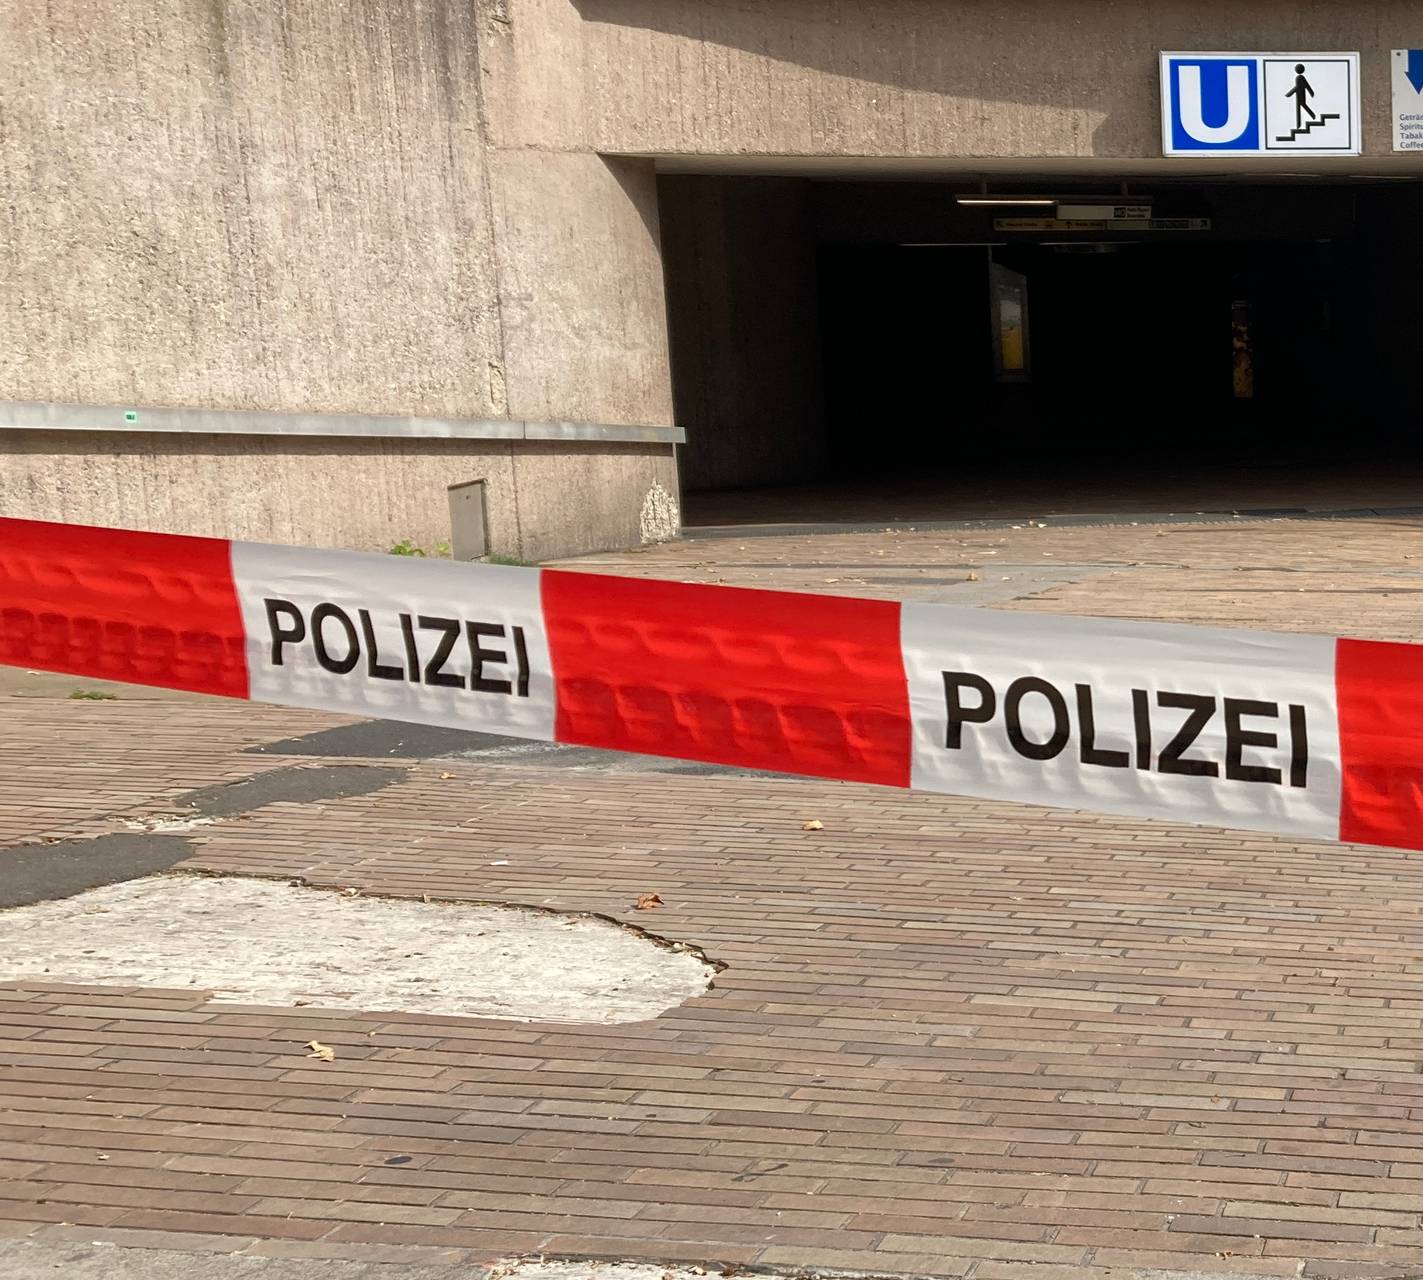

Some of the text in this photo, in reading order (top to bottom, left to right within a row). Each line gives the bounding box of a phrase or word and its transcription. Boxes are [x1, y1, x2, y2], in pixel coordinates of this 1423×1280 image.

[1178, 65, 1250, 144] U
[264, 598, 530, 698] POLIZEI
[941, 670, 1308, 789] POLIZEI
